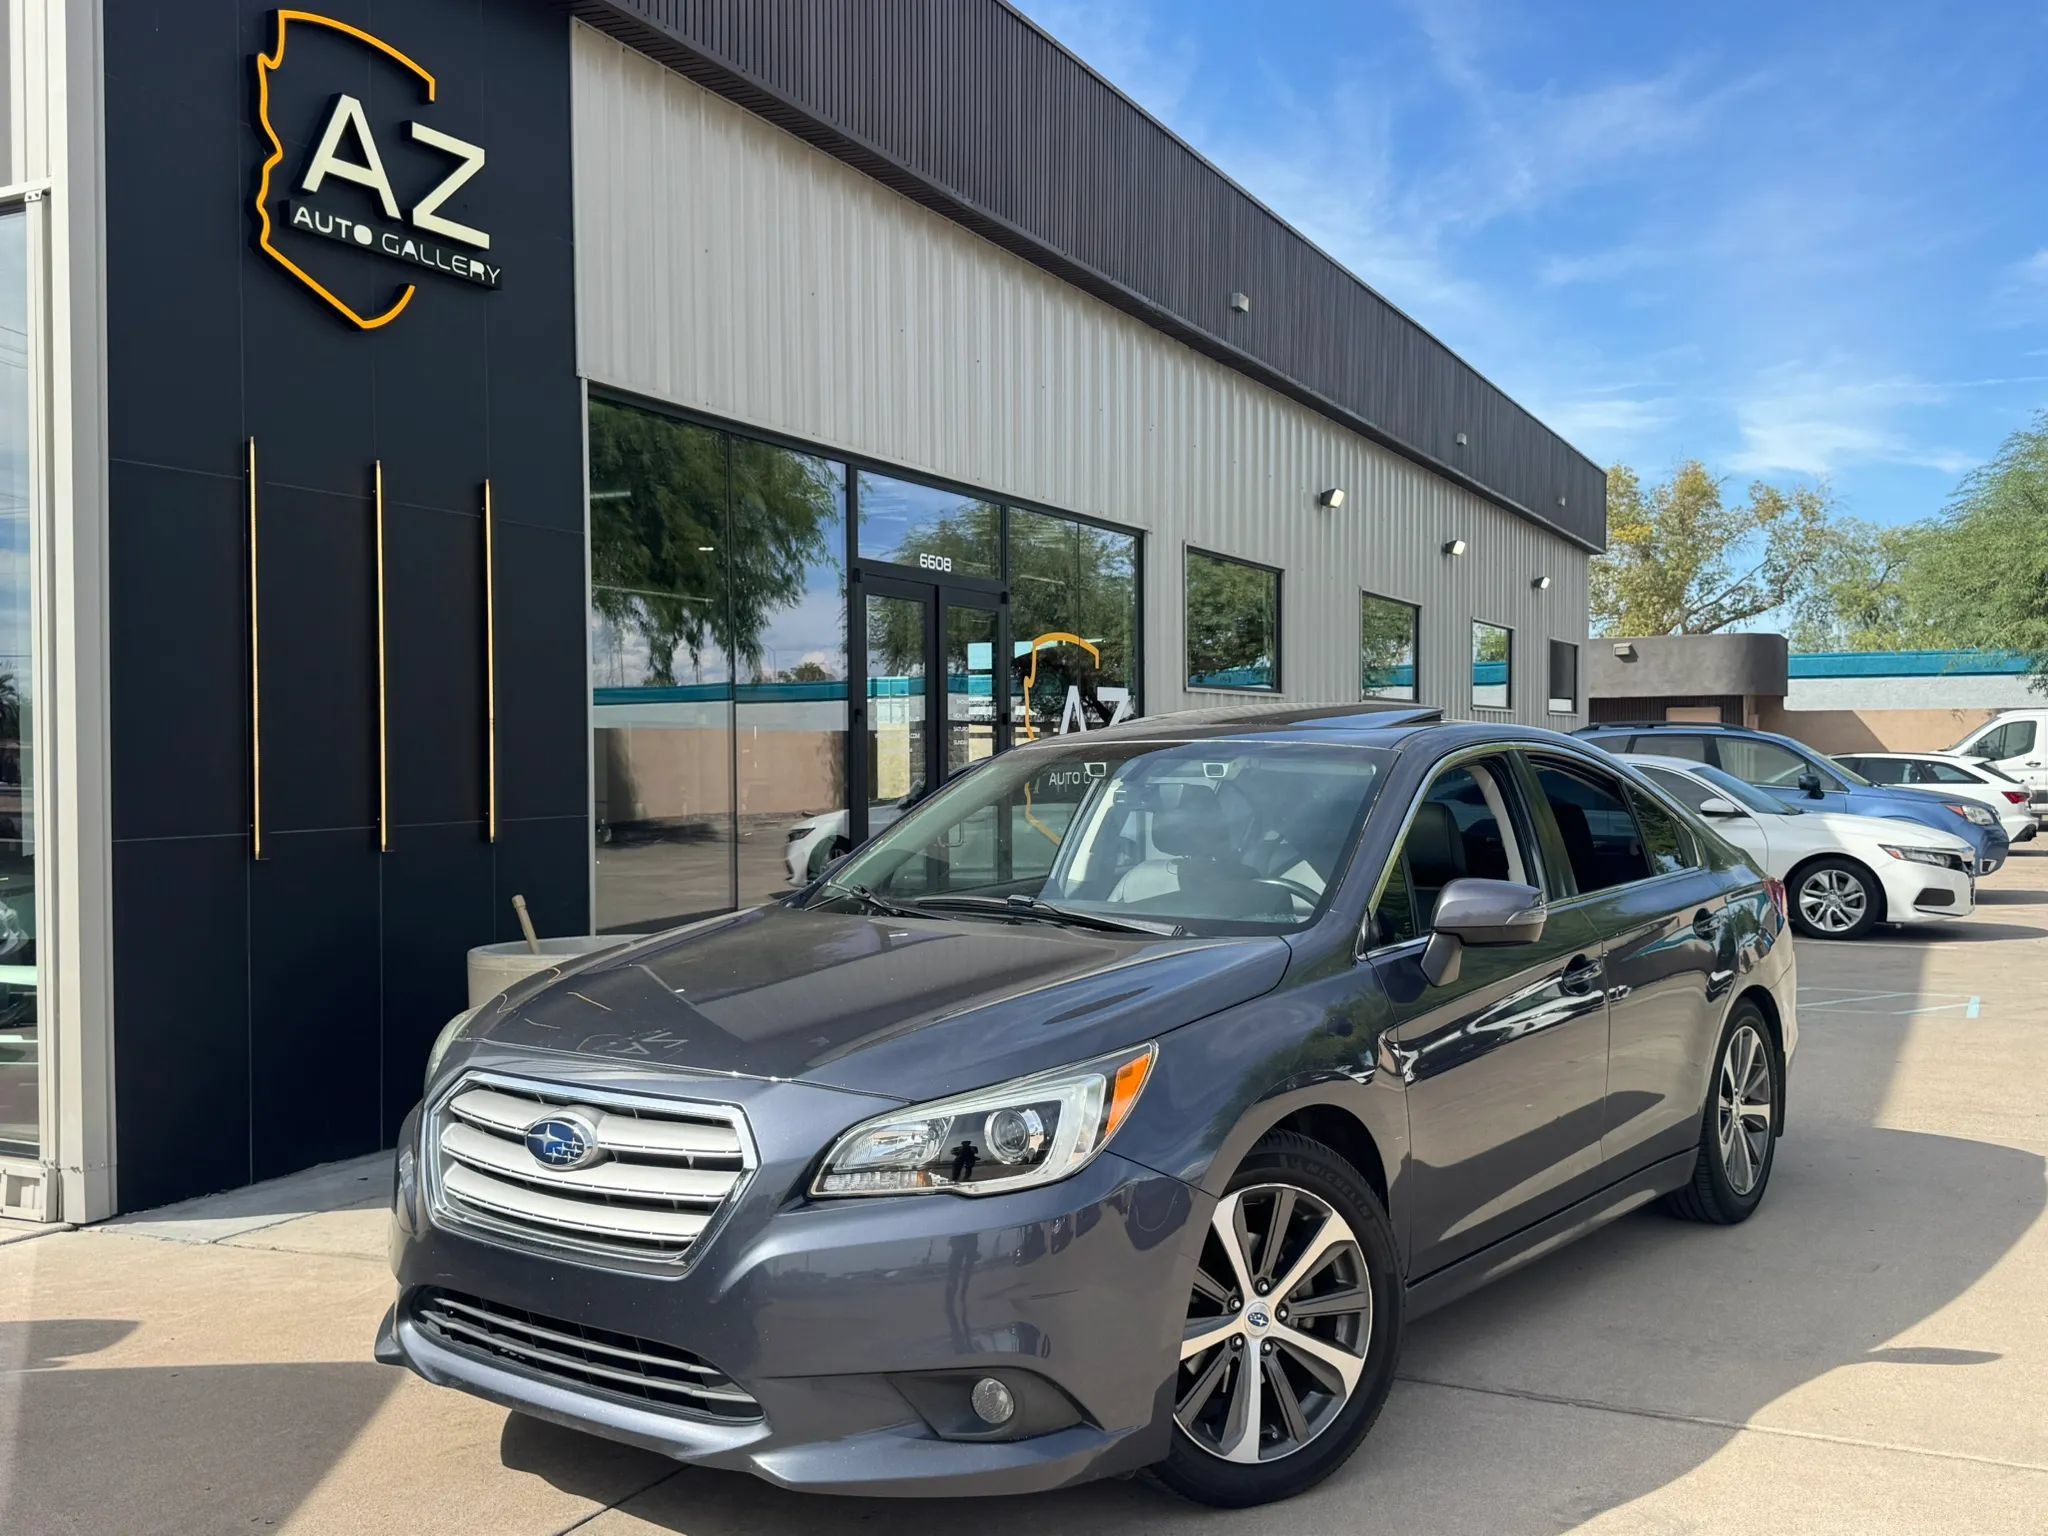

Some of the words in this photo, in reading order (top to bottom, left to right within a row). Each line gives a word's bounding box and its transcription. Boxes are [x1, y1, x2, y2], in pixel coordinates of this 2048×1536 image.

[302, 94, 490, 250] AZ
[293, 206, 374, 246] AUTO
[382, 232, 501, 285] GALLERY
[919, 552, 952, 572] 6608
[1049, 771, 1082, 787] AUTO
